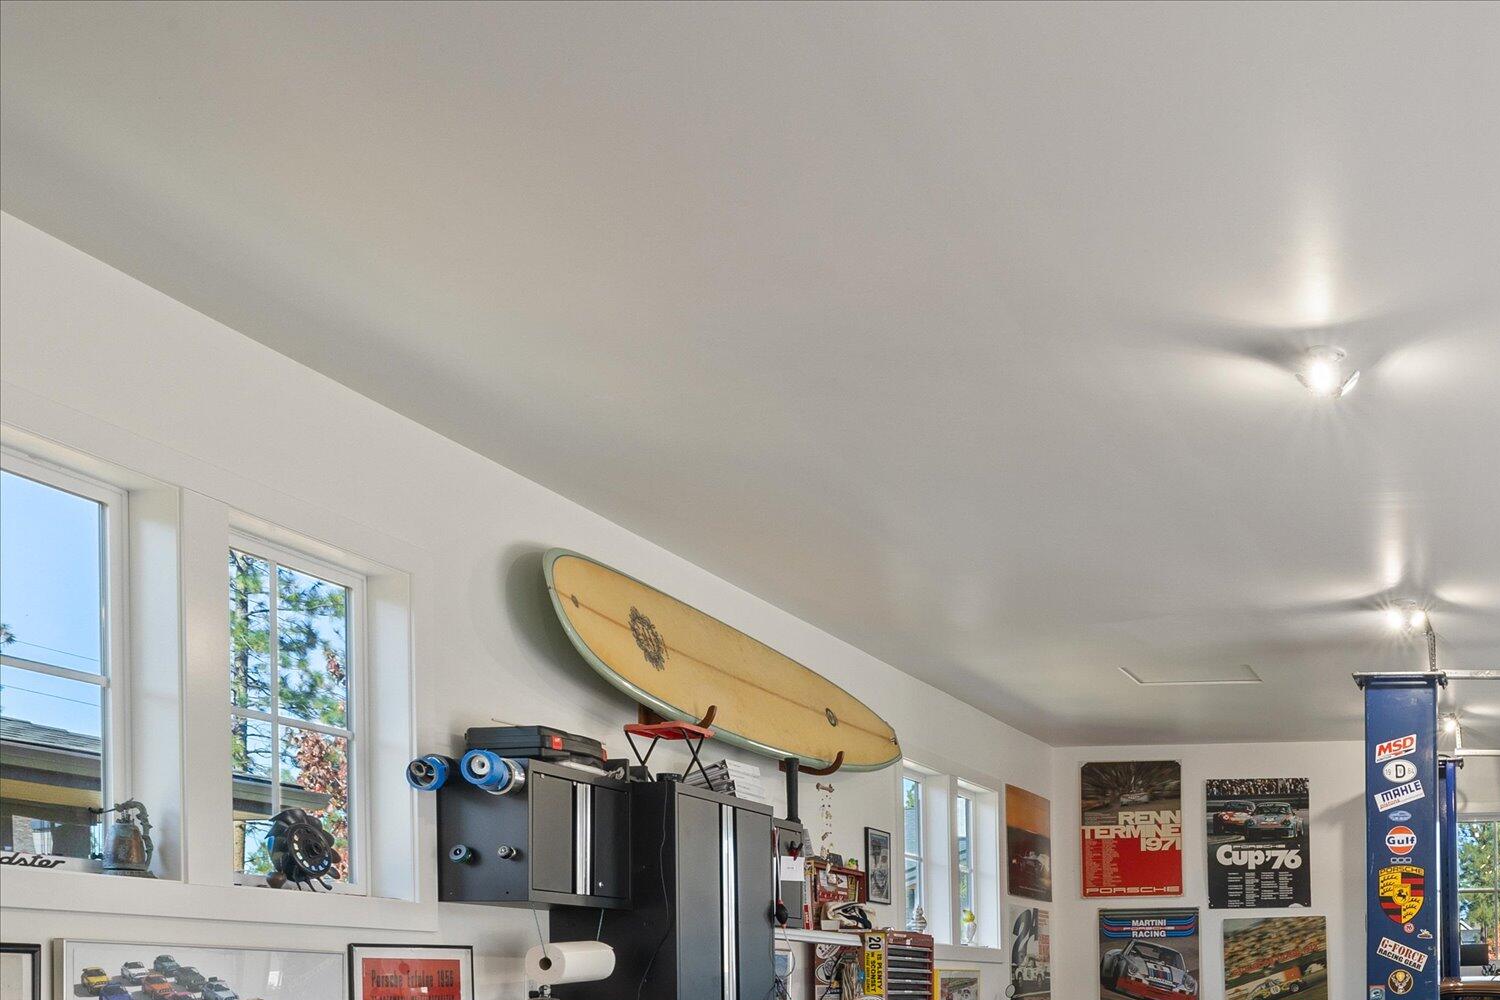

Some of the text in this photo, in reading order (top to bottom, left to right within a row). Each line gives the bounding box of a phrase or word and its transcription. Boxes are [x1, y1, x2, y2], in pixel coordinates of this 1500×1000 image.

[1377, 736, 1415, 757] MSD
[1395, 764, 1406, 779] D
[1380, 781, 1422, 803] MAHLE
[1118, 810, 1180, 825] RENN
[1081, 824, 1181, 839] TERMINE
[1140, 837, 1181, 851] 1971
[1387, 836, 1415, 845] Gulf
[1086, 885, 1180, 894] PORSCHE
[1132, 930, 1166, 938] RACING
[868, 937, 881, 950] 20
[1381, 938, 1425, 964] G-FORCE
[1378, 947, 1422, 969] RACING GEAR
